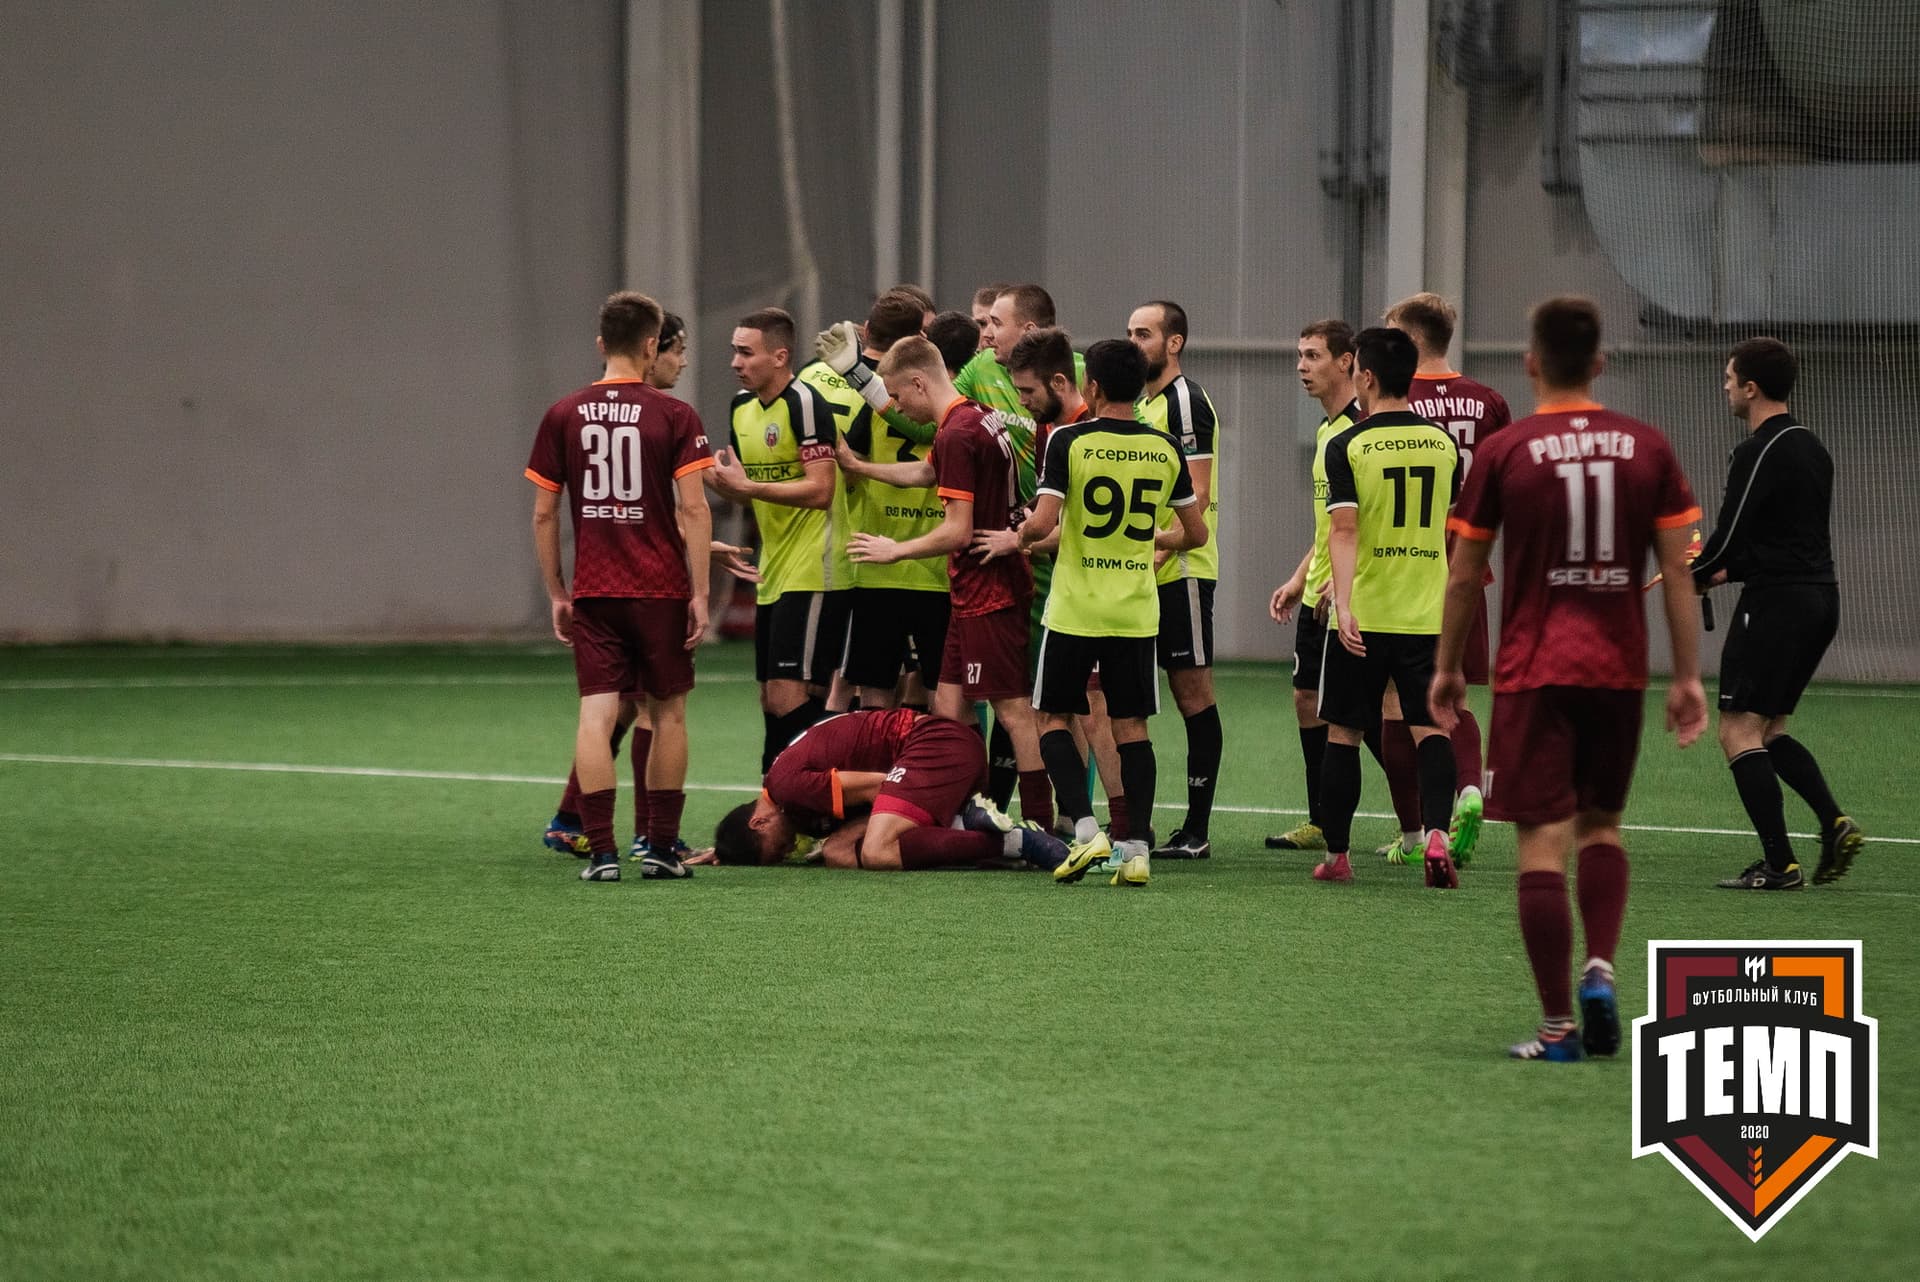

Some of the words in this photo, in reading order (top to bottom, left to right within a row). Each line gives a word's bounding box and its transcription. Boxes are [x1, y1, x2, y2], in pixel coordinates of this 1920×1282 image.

[578, 402, 642, 423] ЧЕРНОВ
[802, 446, 836, 460] CAPT
[1375, 438, 1446, 452] сервико
[1528, 430, 1636, 465] РОДИЧЕВ
[580, 424, 643, 501] 30
[1095, 448, 1168, 464] сервико
[747, 465, 792, 480] РКУТСК
[1382, 466, 1436, 528] 11
[582, 505, 644, 519] SEUS
[1082, 476, 1164, 541] 95
[1555, 461, 1615, 562] 11
[1385, 546, 1407, 557] RVM
[1410, 546, 1440, 561] Group
[1097, 557, 1122, 570] RVM
[1125, 559, 1148, 571] Gro
[1546, 568, 1630, 585] SEUS
[967, 663, 982, 684] 27
